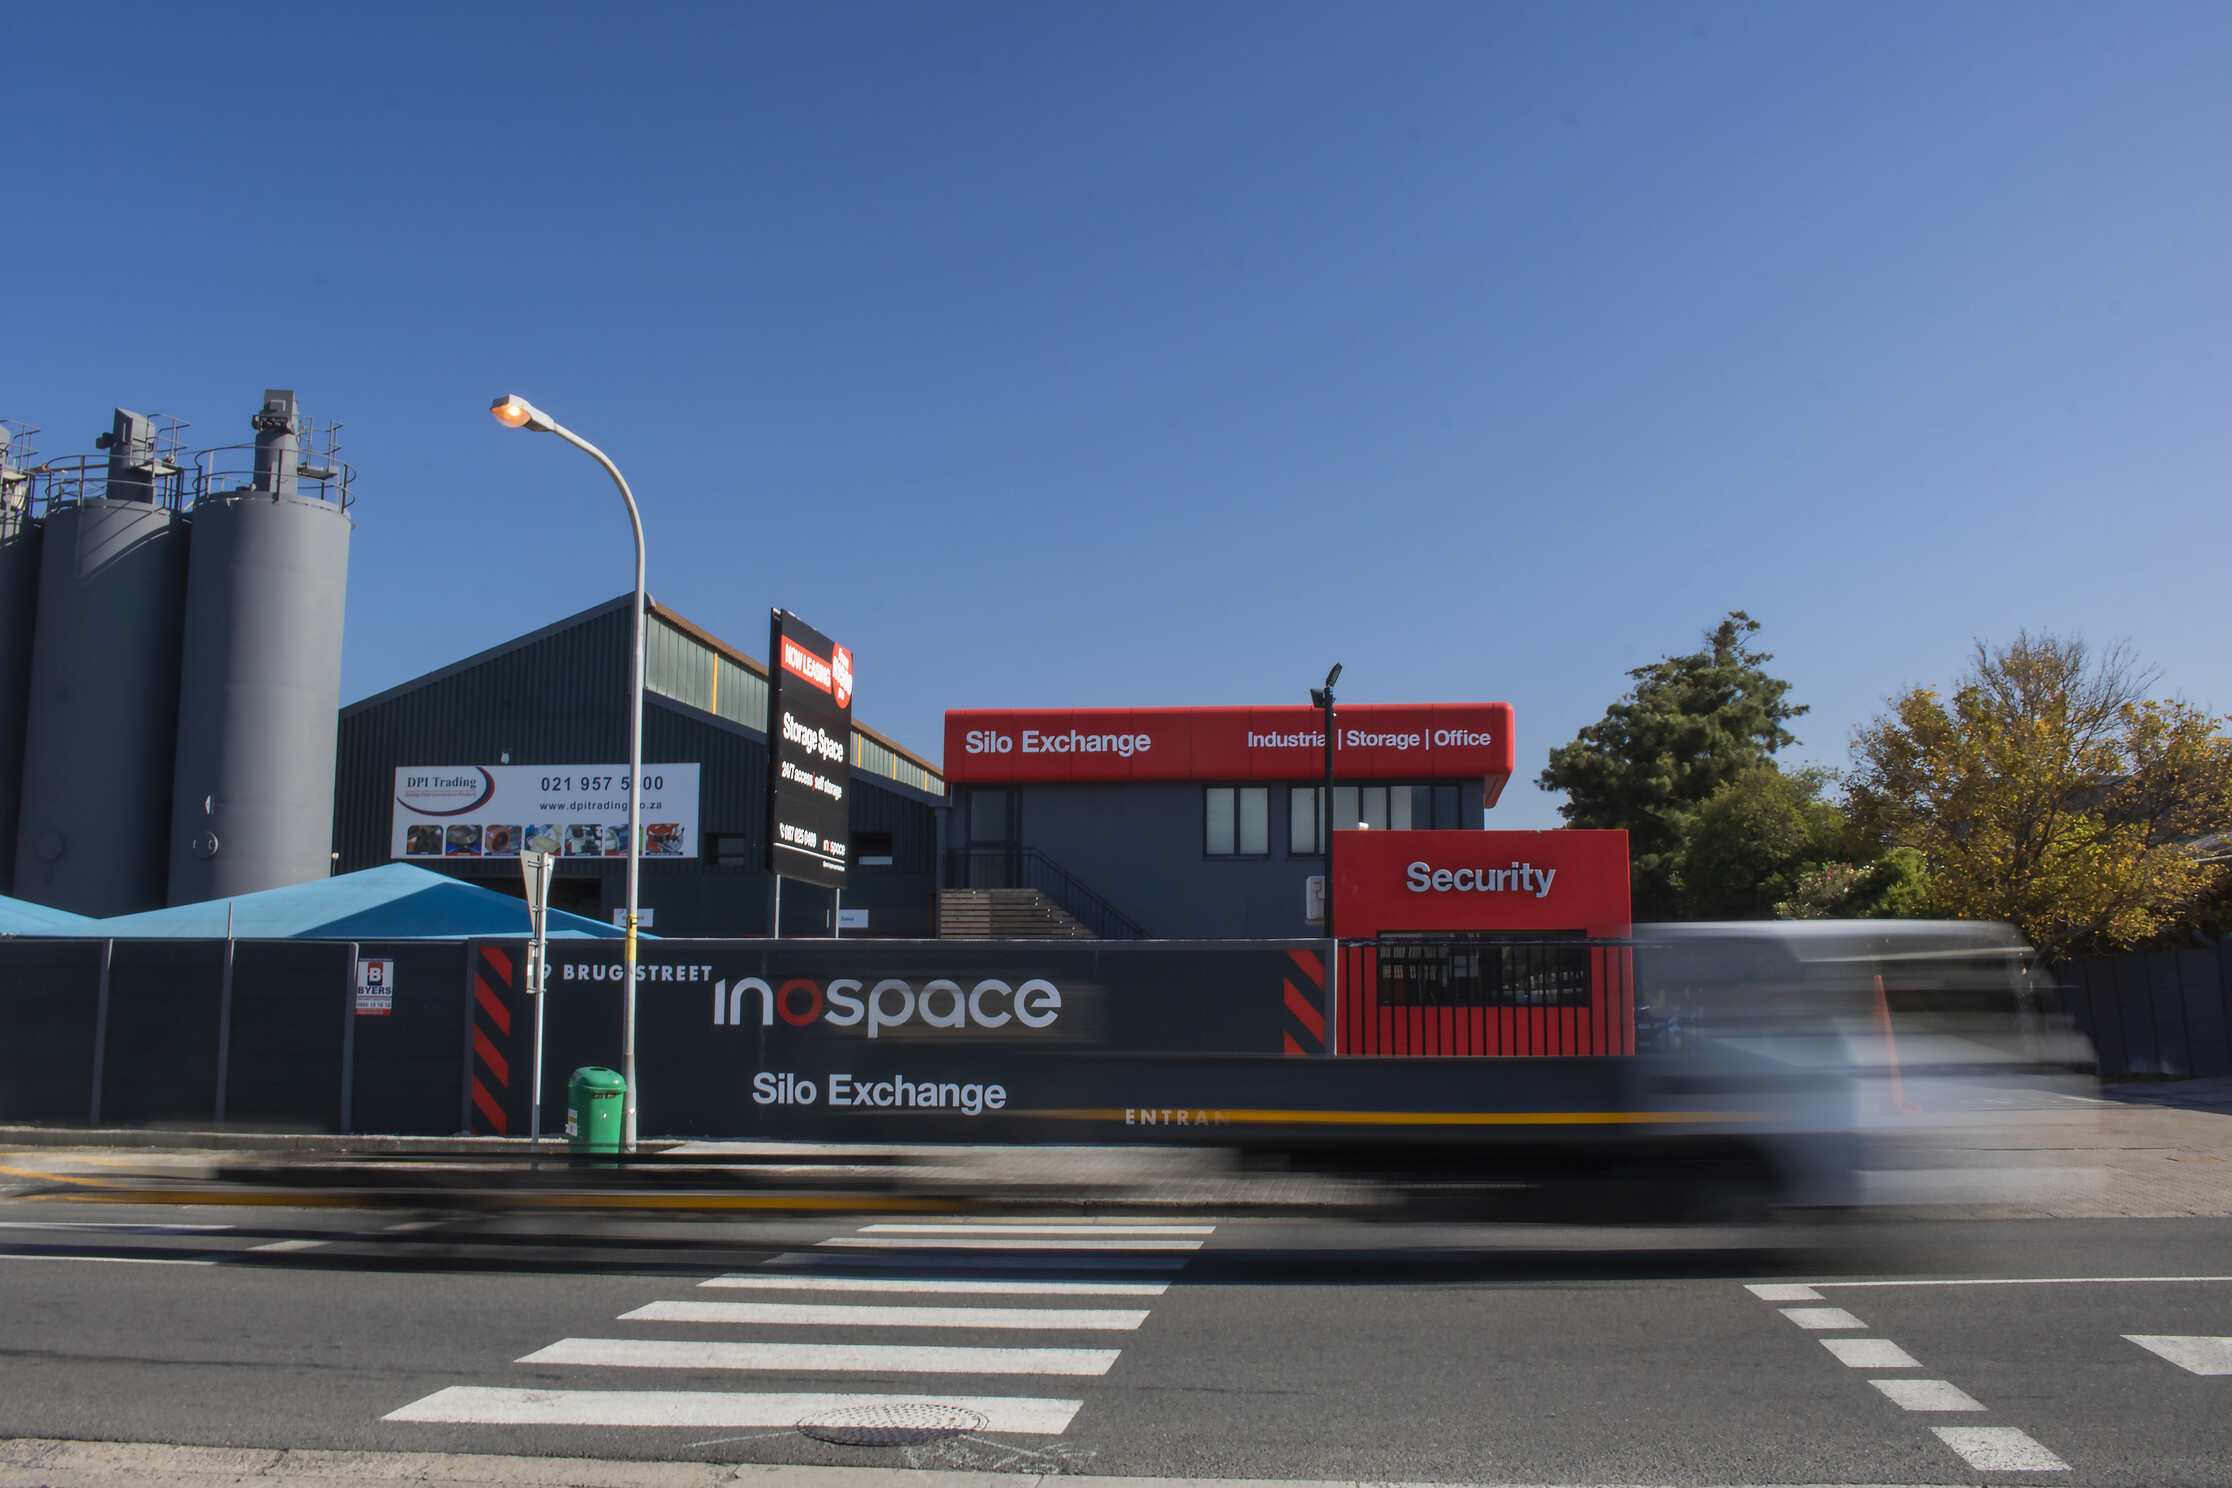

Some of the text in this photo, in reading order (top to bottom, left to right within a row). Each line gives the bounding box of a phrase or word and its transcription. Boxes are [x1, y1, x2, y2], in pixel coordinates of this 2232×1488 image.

[785, 643, 831, 687] NOW LEASING
[783, 712, 844, 762] Storage Space
[965, 729, 1151, 757] Silo Exchange
[1248, 729, 1491, 750] Industria Storage Office
[407, 776, 477, 789] DPI Trading
[541, 776, 664, 791] 021 957 500
[540, 801, 662, 812] www.dpitradingo.za
[1406, 861, 1556, 899] Security
[563, 964, 624, 981] BRUG
[635, 965, 713, 982] STREET
[357, 986, 392, 995] BYERS
[713, 977, 1062, 1039] inospace
[752, 1072, 1007, 1116] Silo Exchange
